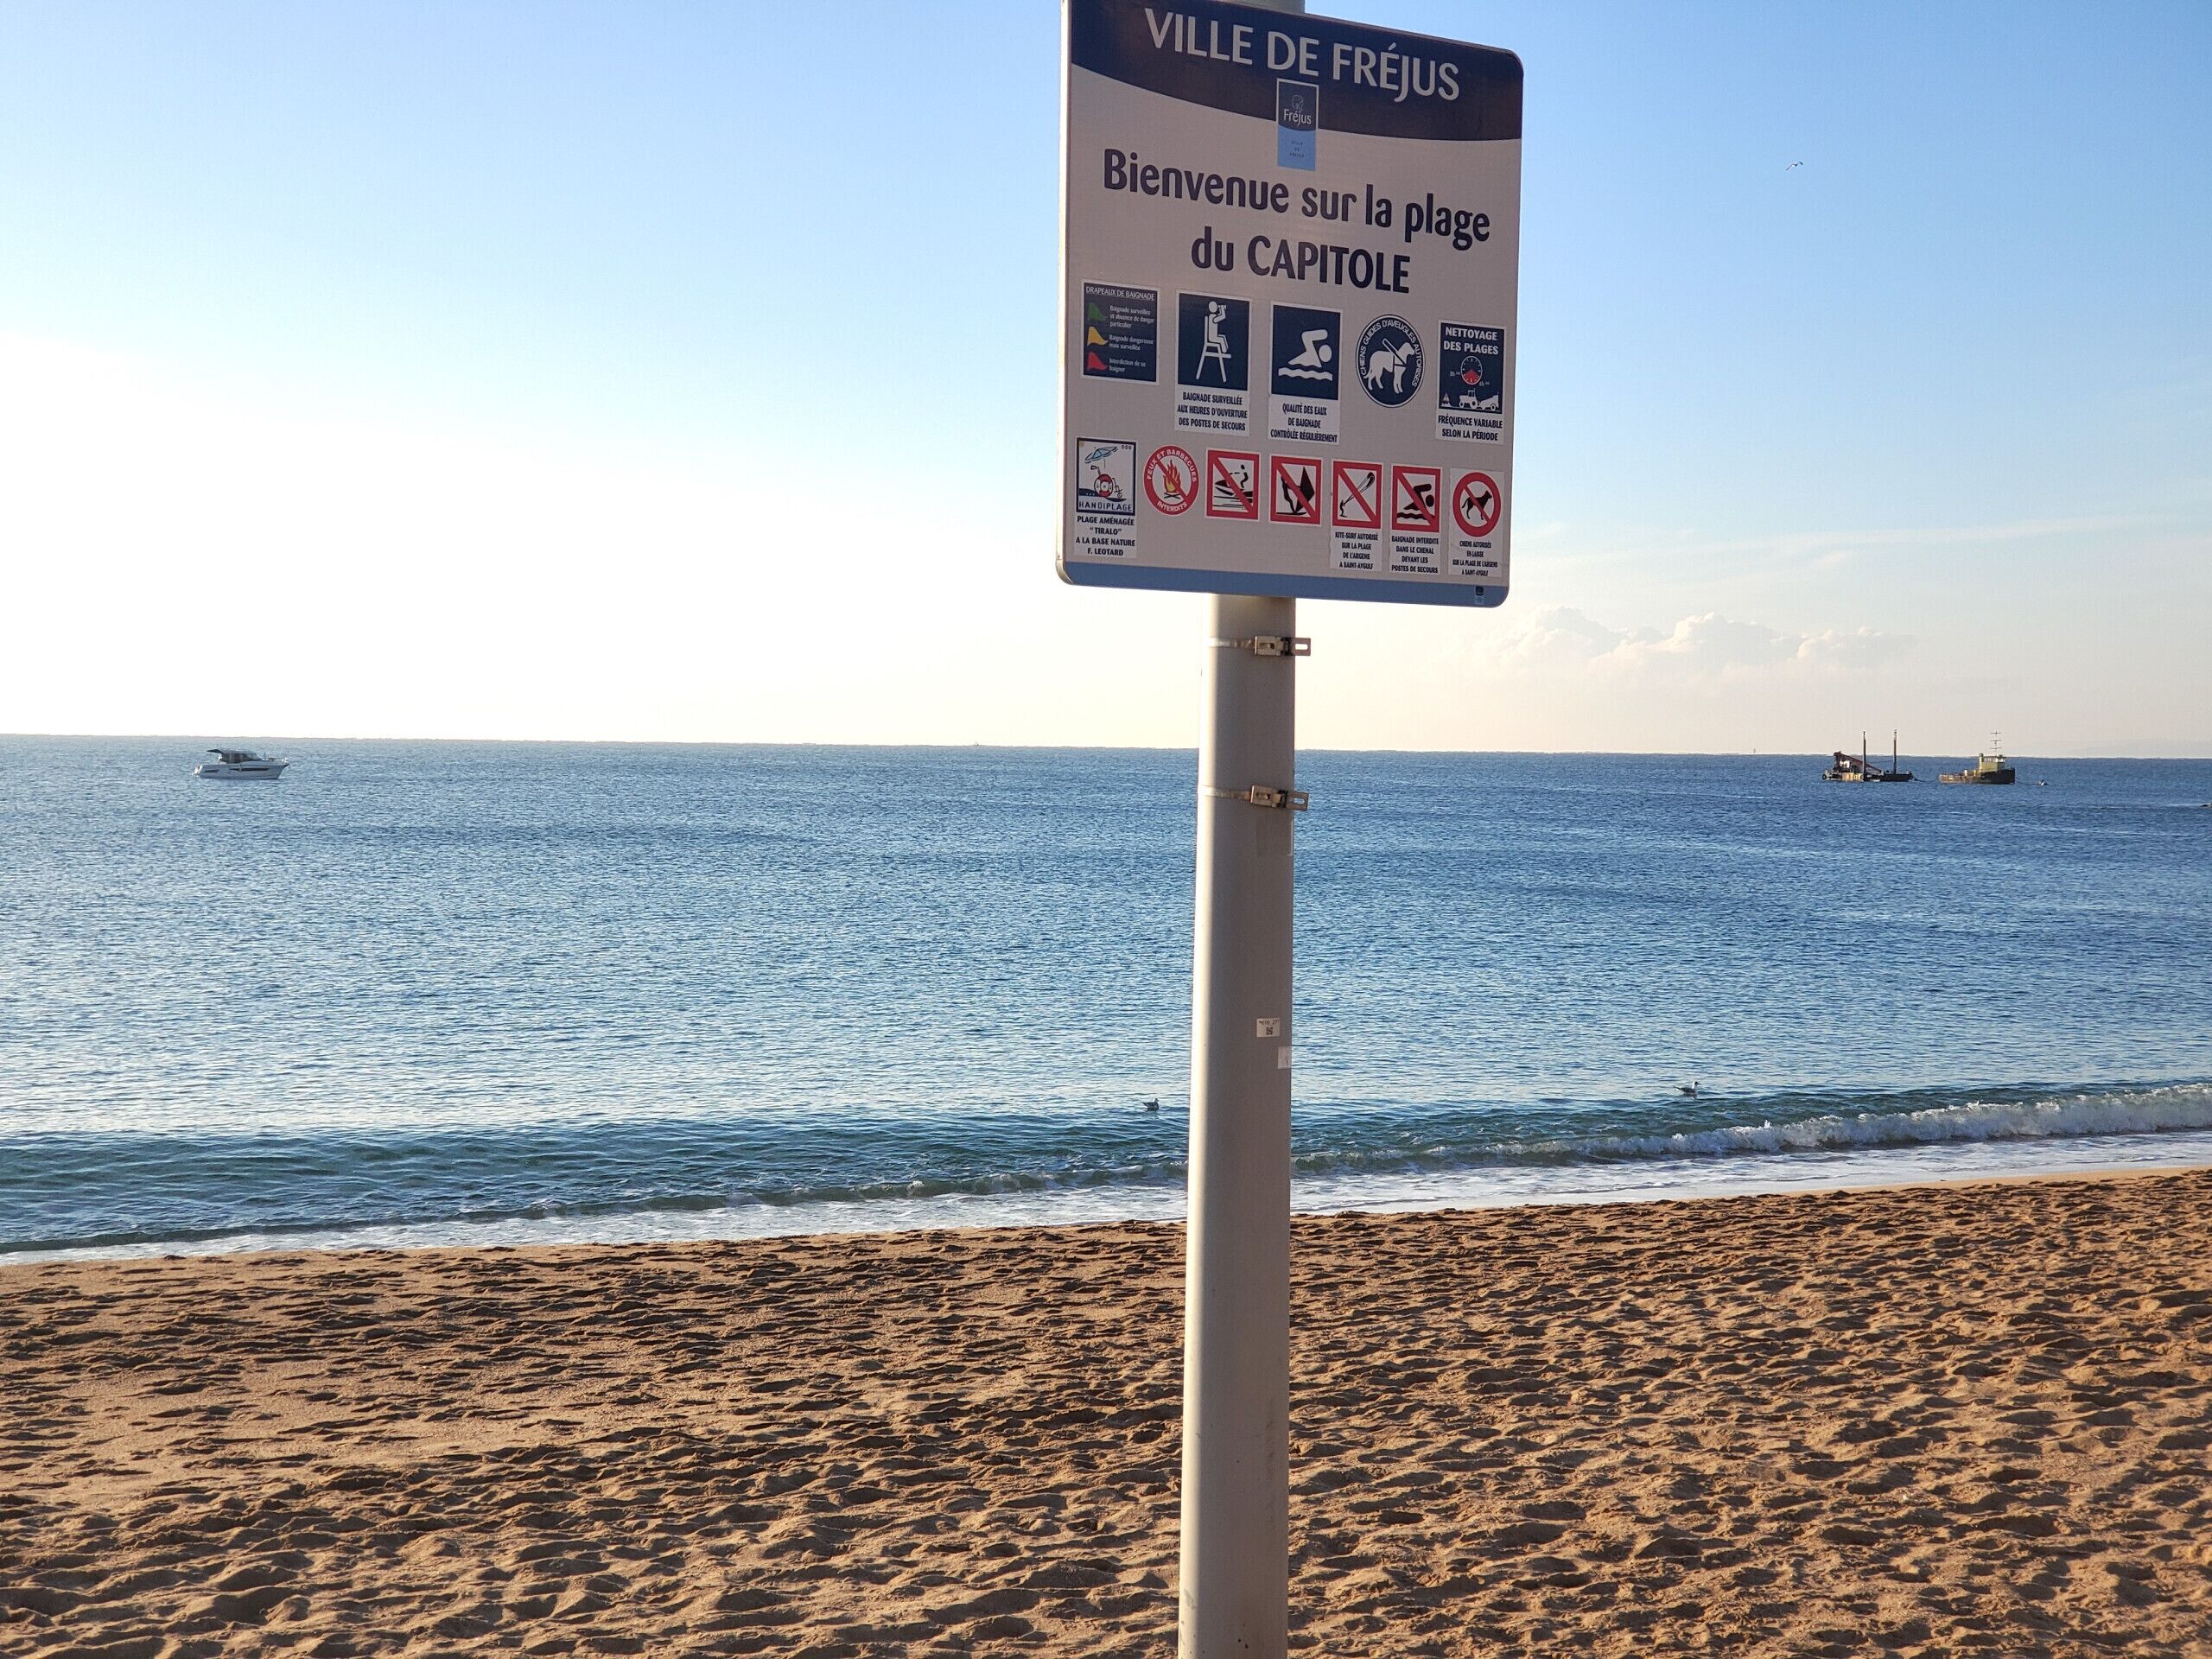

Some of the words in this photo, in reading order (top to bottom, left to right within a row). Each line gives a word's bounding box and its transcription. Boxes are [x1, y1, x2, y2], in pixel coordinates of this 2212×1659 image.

[1144, 8, 1253, 66] VILLE
[1268, 33, 1319, 77] DE
[1333, 43, 1459, 103] FRÉJUS
[1283, 108, 1312, 126] Fréjus
[1104, 148, 1289, 213] Bienvenue
[1302, 187, 1357, 222] sur
[1365, 184, 1393, 228] la
[1405, 193, 1491, 251] plage
[1191, 226, 1234, 271] du
[1247, 235, 1410, 294] CAPITOLE
[1085, 286, 1116, 296] DRAPEAUX
[1126, 290, 1154, 301] BAIGNADE
[1363, 322, 1382, 345] GUIDES
[1382, 320, 1417, 343] D'AVEUGLES
[1446, 327, 1497, 340] NETTOYAGE
[1444, 340, 1461, 352] DES
[1464, 342, 1498, 355] PLAGES
[1183, 392, 1211, 403] BAIGNADE
[1212, 394, 1243, 405] SURVEILLÉE
[1177, 404, 1188, 413] AUX
[1189, 405, 1211, 415] HEURES
[1211, 407, 1248, 418] D'OUVERTURE
[1282, 402, 1303, 414] QUALITÉ
[1304, 405, 1313, 415] DES
[1314, 406, 1327, 416] EAUX
[1179, 417, 1189, 426] DES
[1191, 418, 1211, 428] POSTES
[1222, 421, 1246, 431] SECOURS
[1288, 417, 1294, 426] DE
[1296, 418, 1321, 429] BAIGNADE
[1438, 413, 1472, 427] FRÉQUENCE
[1474, 418, 1503, 429] VARIABLE
[1270, 428, 1298, 439] CONTRÔLÉE
[1442, 429, 1461, 437] SELON
[1472, 429, 1498, 441] PÉRIODE
[1147, 458, 1157, 480] FEUX
[1156, 450, 1166, 460] ET
[1166, 449, 1197, 482] BARBECUES
[1079, 501, 1132, 511] HANDIPLAGE
[1157, 501, 1187, 512] INTERDITS
[1077, 515, 1097, 524] PLAGE
[1099, 516, 1135, 525] AMÉNAGÉE
